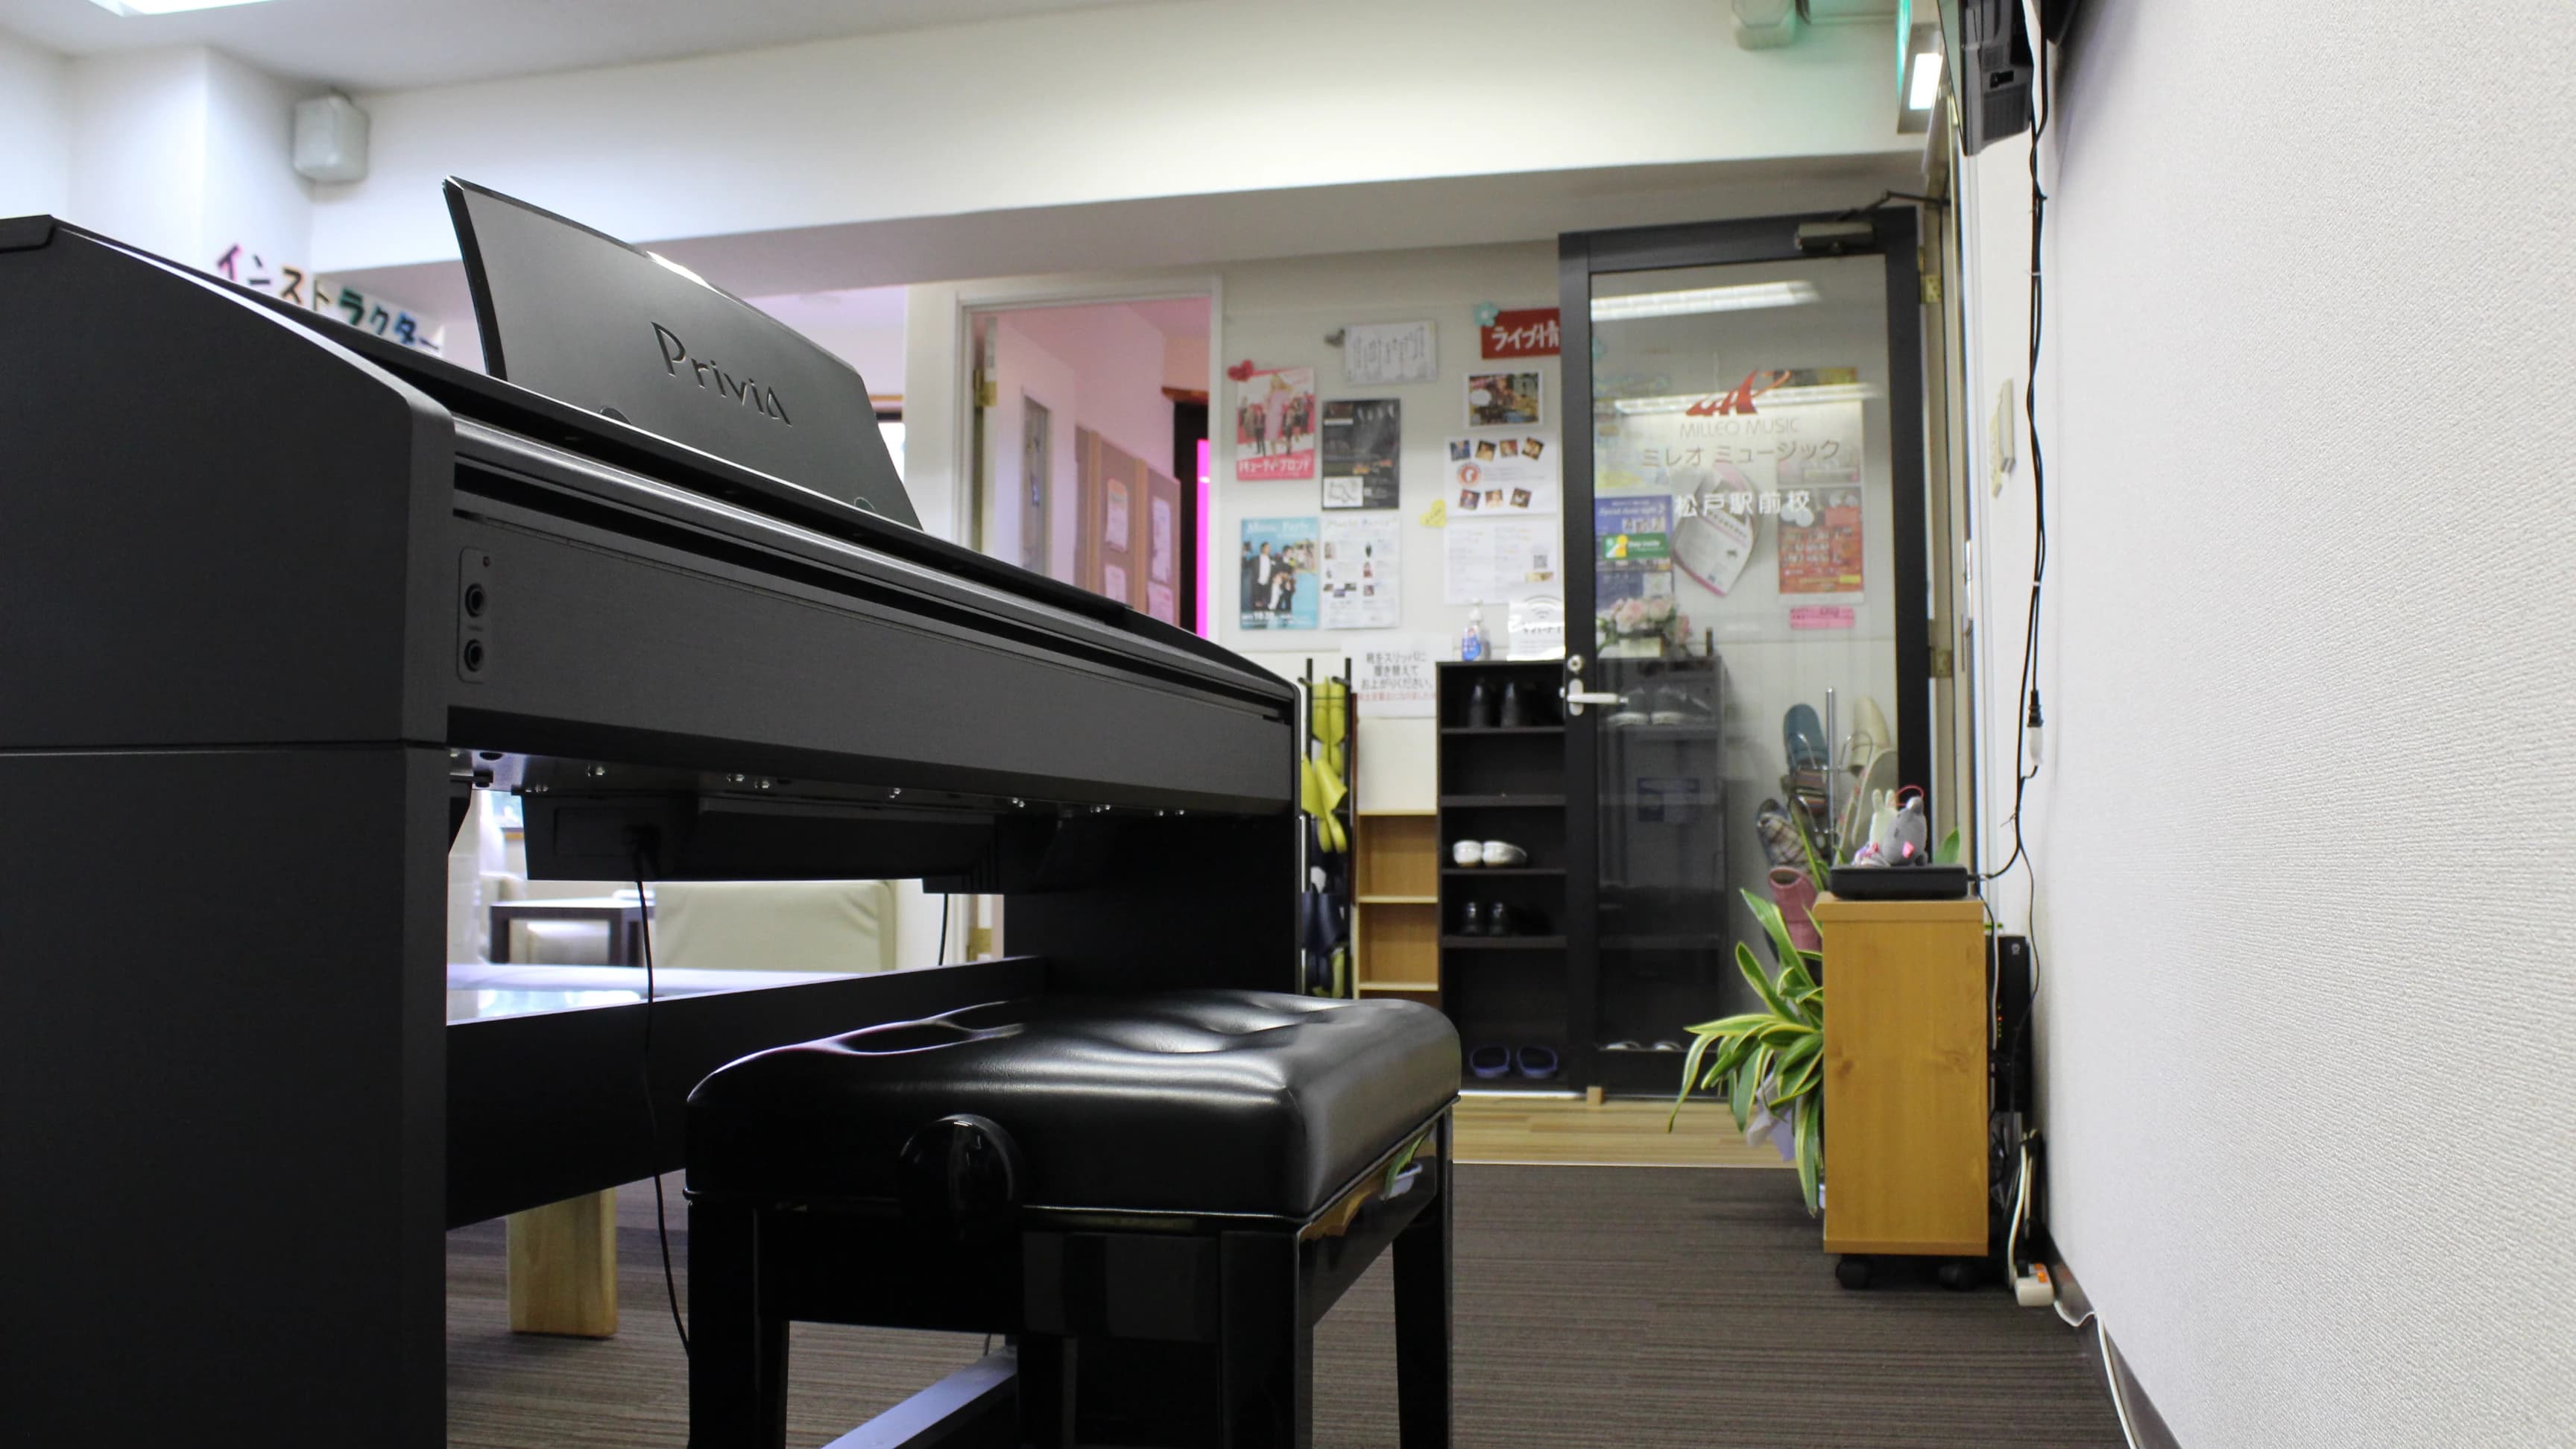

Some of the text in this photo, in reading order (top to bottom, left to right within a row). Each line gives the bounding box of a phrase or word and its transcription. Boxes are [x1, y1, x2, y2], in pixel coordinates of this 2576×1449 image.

[217, 244, 440, 350] インストラクター
[651, 321, 792, 427] Privia
[1680, 417, 1801, 439] MILLEO MUSIC
[1642, 439, 1840, 467] ミレオ ミュージック
[1675, 490, 1811, 518] 松戸駅前校
